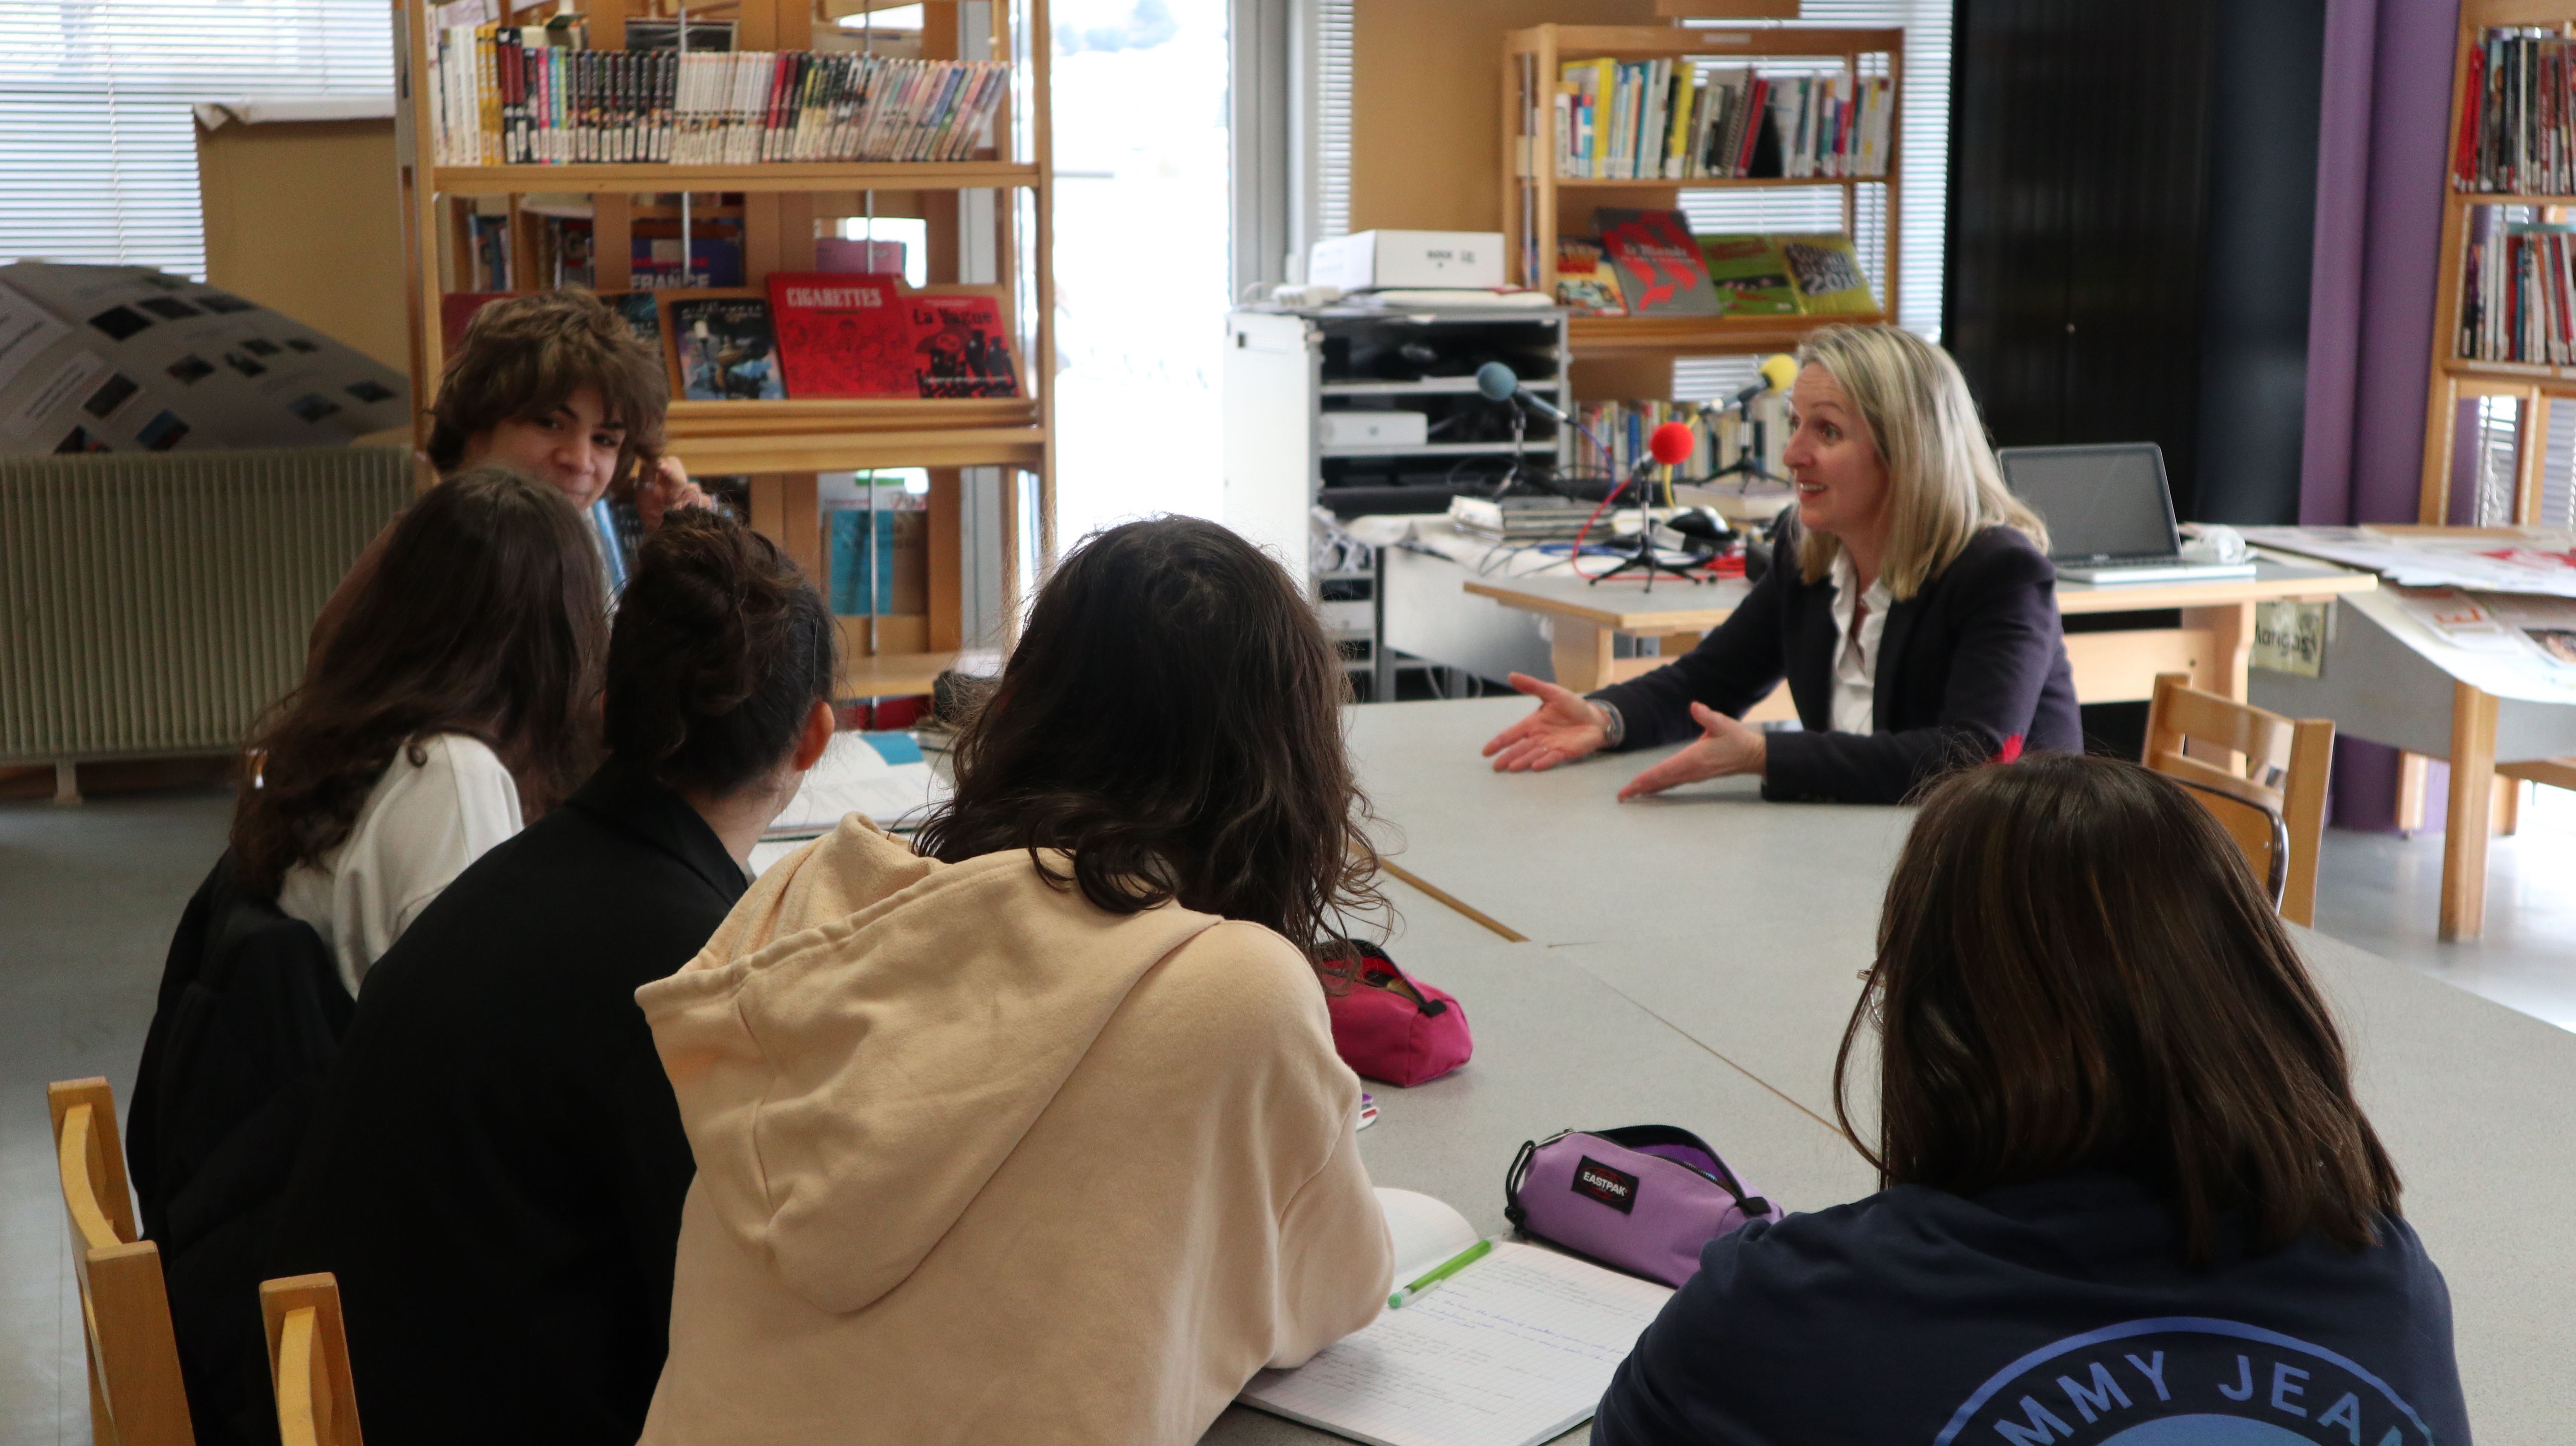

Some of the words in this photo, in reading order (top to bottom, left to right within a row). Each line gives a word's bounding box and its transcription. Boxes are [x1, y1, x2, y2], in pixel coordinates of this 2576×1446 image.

[786, 287, 882, 307] CIGARETTES
[914, 308, 934, 325] La
[939, 307, 993, 326] Vague
[1583, 1171, 1626, 1197] EASTPAK
[1993, 1351, 2171, 1446] MMY
